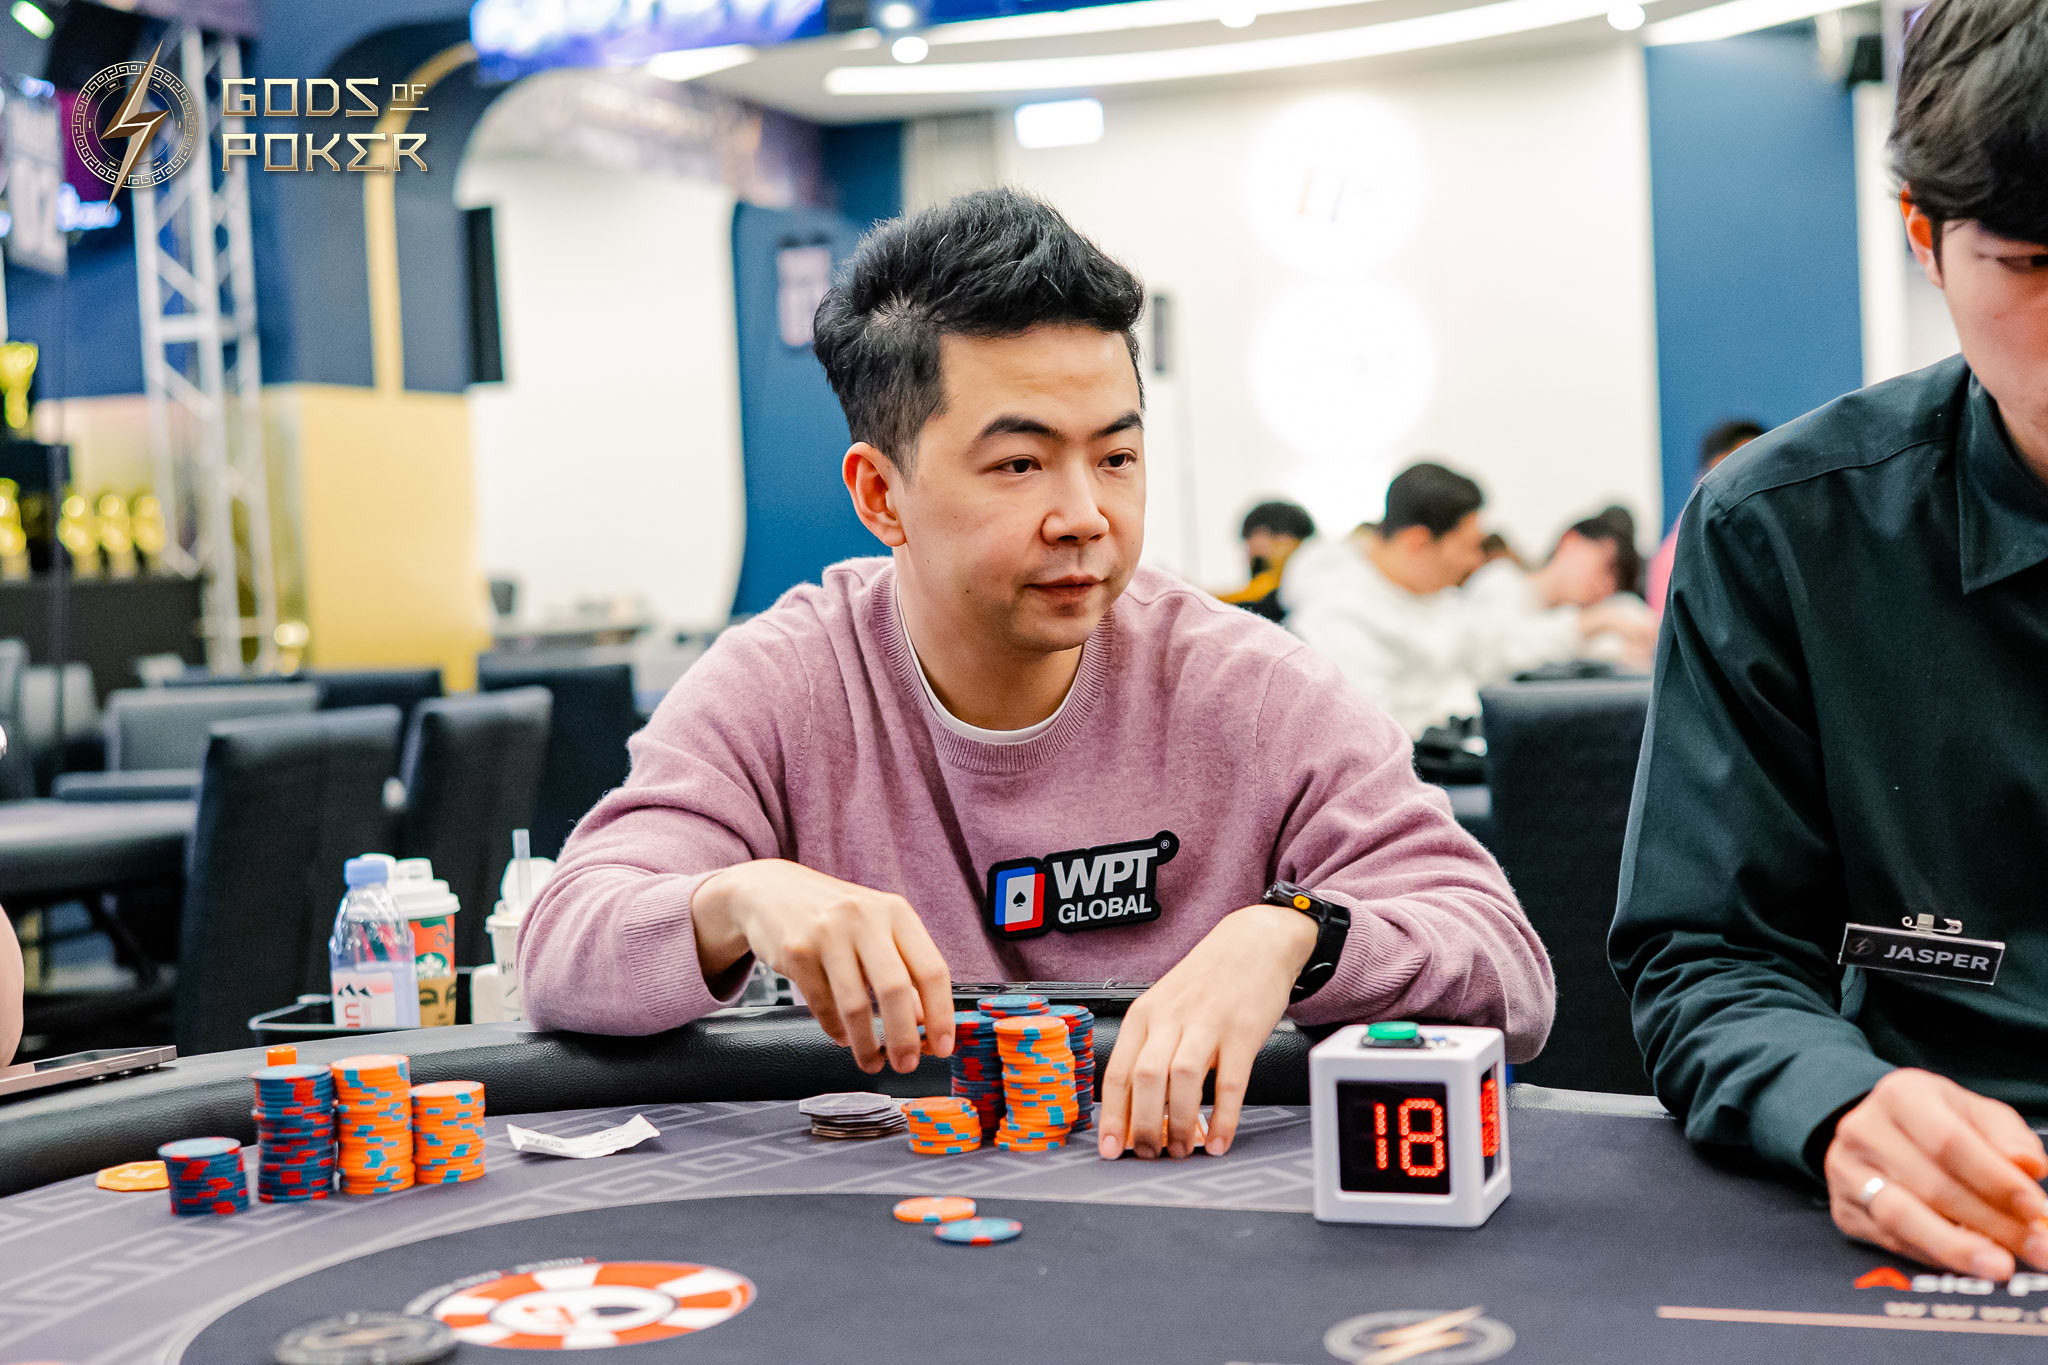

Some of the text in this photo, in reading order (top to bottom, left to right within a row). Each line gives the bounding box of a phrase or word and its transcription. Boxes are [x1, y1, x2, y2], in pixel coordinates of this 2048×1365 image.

[1052, 847, 1159, 900] WPT
[1057, 893, 1152, 925] GLOBAL
[1883, 944, 1990, 972] JASPER
[1374, 1098, 1445, 1177] 18
